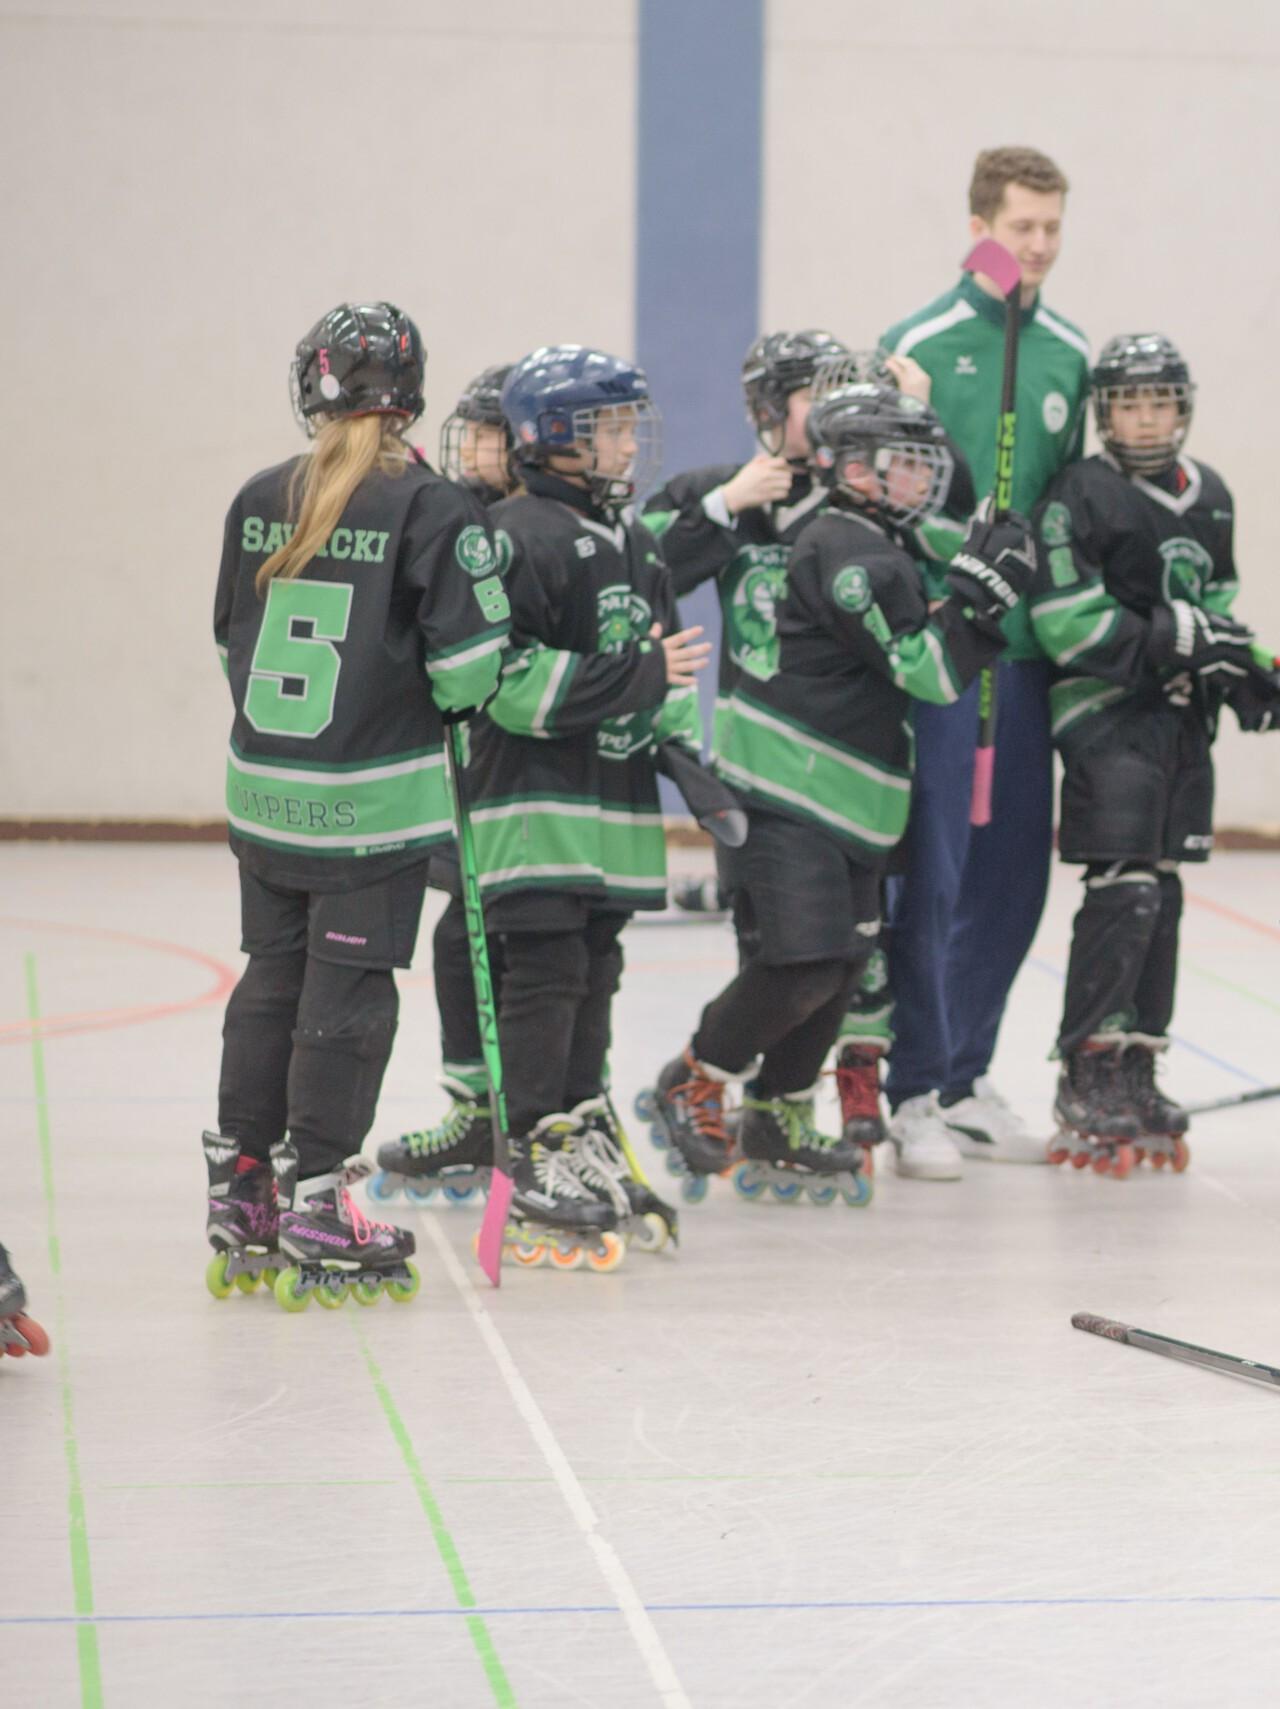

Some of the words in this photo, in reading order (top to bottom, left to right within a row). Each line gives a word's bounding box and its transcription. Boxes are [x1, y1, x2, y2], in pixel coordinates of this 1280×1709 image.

[997, 412, 1016, 510] CCM
[242, 516, 389, 563] SACKI
[243, 577, 354, 739] 5
[237, 785, 356, 829] VIPERS
[288, 1224, 351, 1248] MISSION
